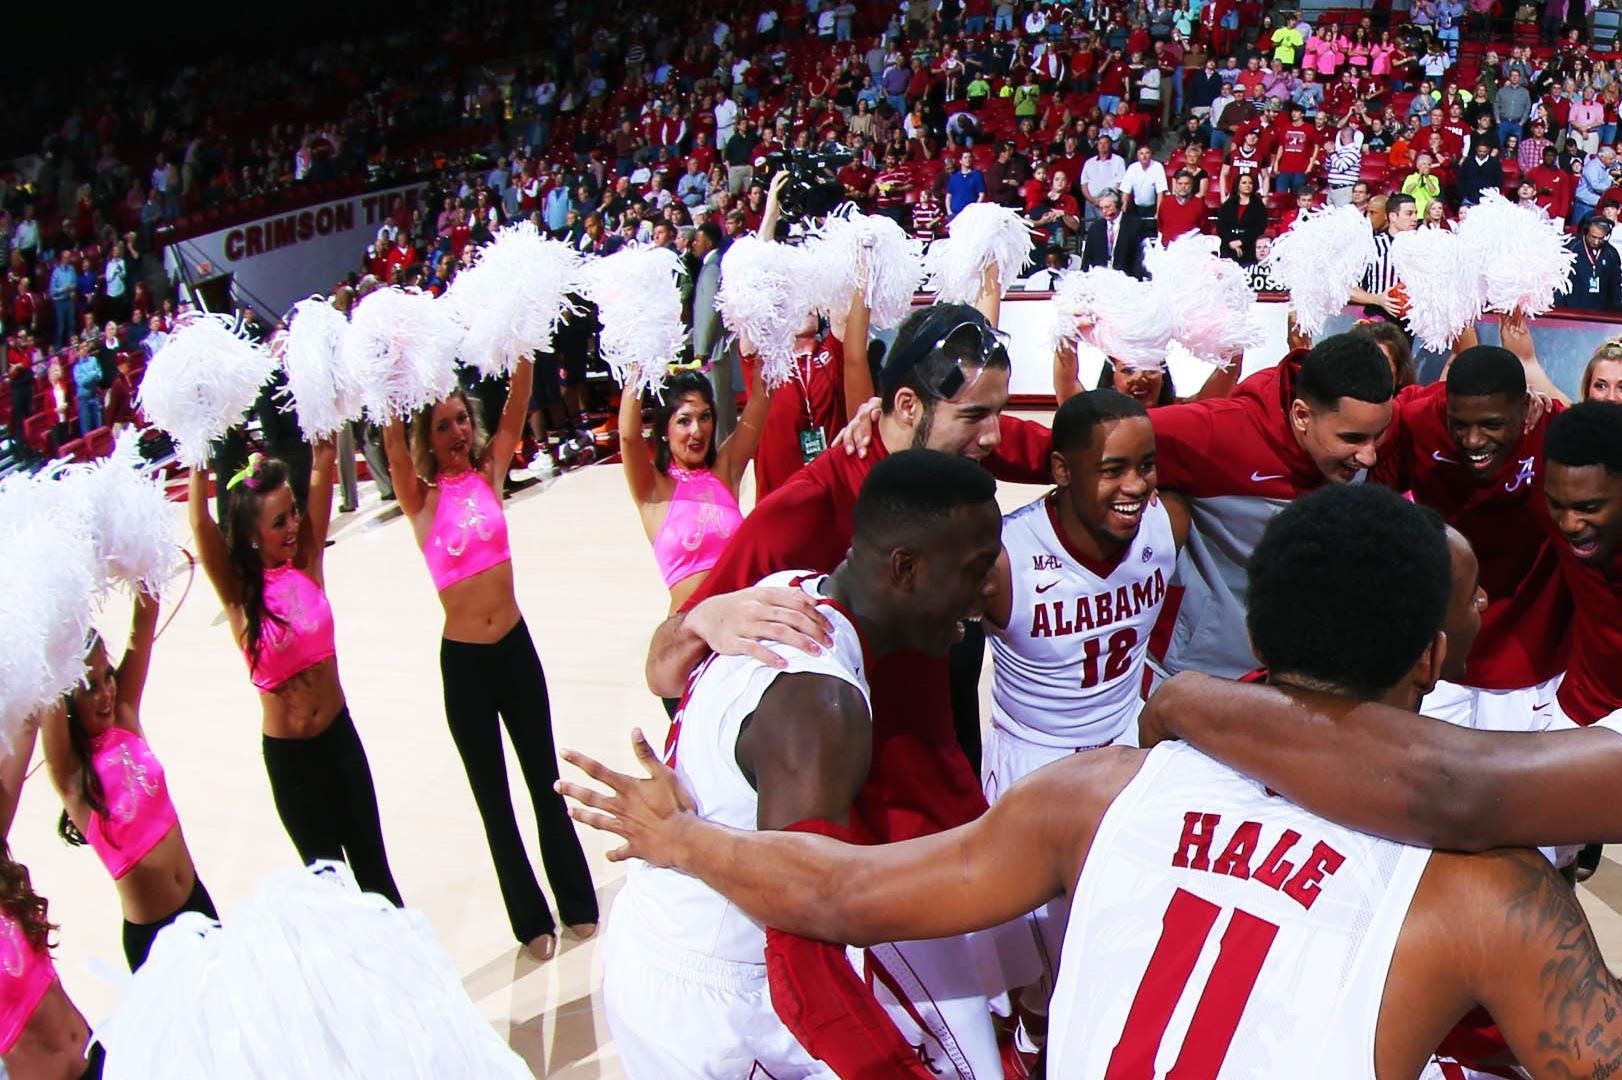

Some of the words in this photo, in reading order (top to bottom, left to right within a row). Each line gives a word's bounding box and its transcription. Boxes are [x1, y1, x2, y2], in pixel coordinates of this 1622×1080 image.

[224, 202, 355, 262] CRIMSON
[1030, 567, 1166, 638] ALABAMA
[1080, 627, 1138, 689] 12
[1172, 811, 1346, 911] HALE
[1104, 887, 1280, 1080] 11
